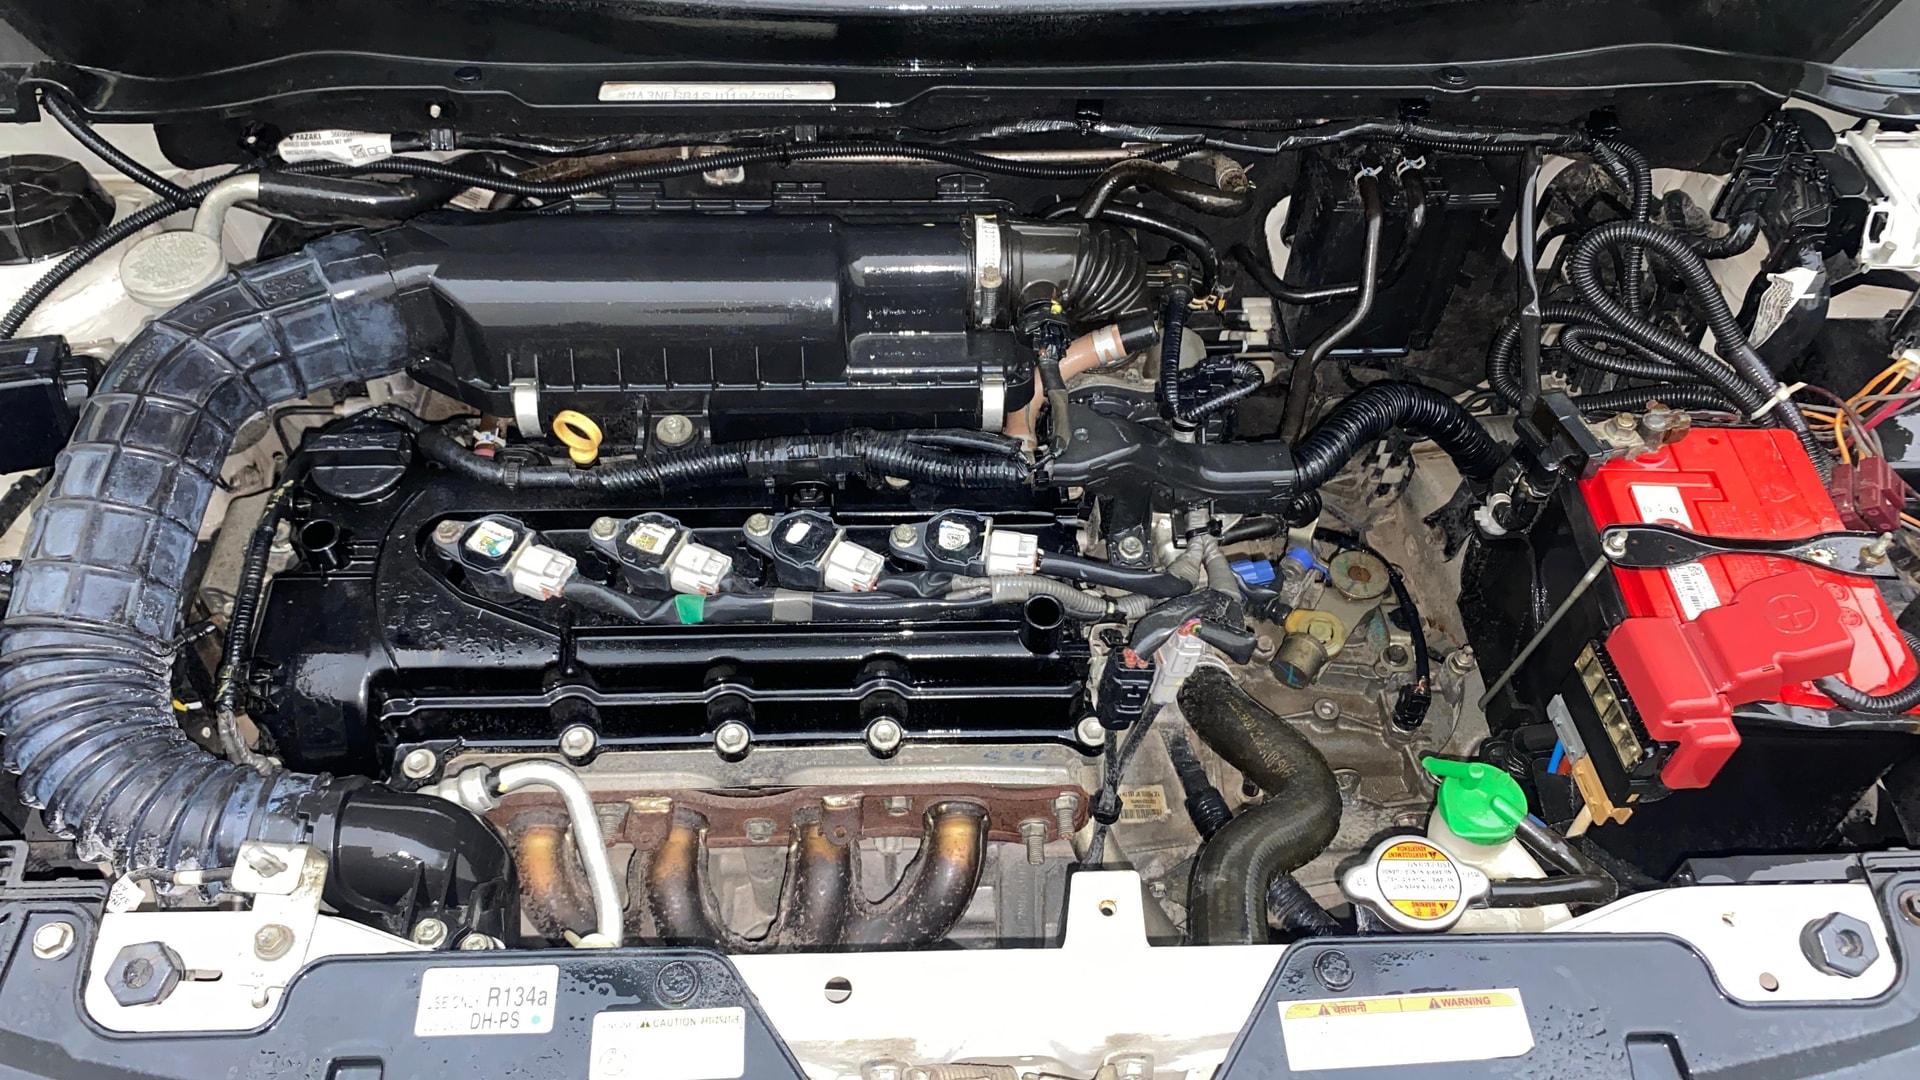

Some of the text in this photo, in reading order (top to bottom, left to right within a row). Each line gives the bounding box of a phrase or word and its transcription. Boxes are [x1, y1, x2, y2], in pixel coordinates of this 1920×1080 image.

[296, 133, 322, 141] YAZAKI
[487, 986, 548, 1007] R134a
[1440, 996, 1491, 1008] WARNING
[1332, 1002, 1367, 1015] चेतावनी
[470, 1011, 520, 1029] DH-PS
[653, 1017, 697, 1027] CAUTION
